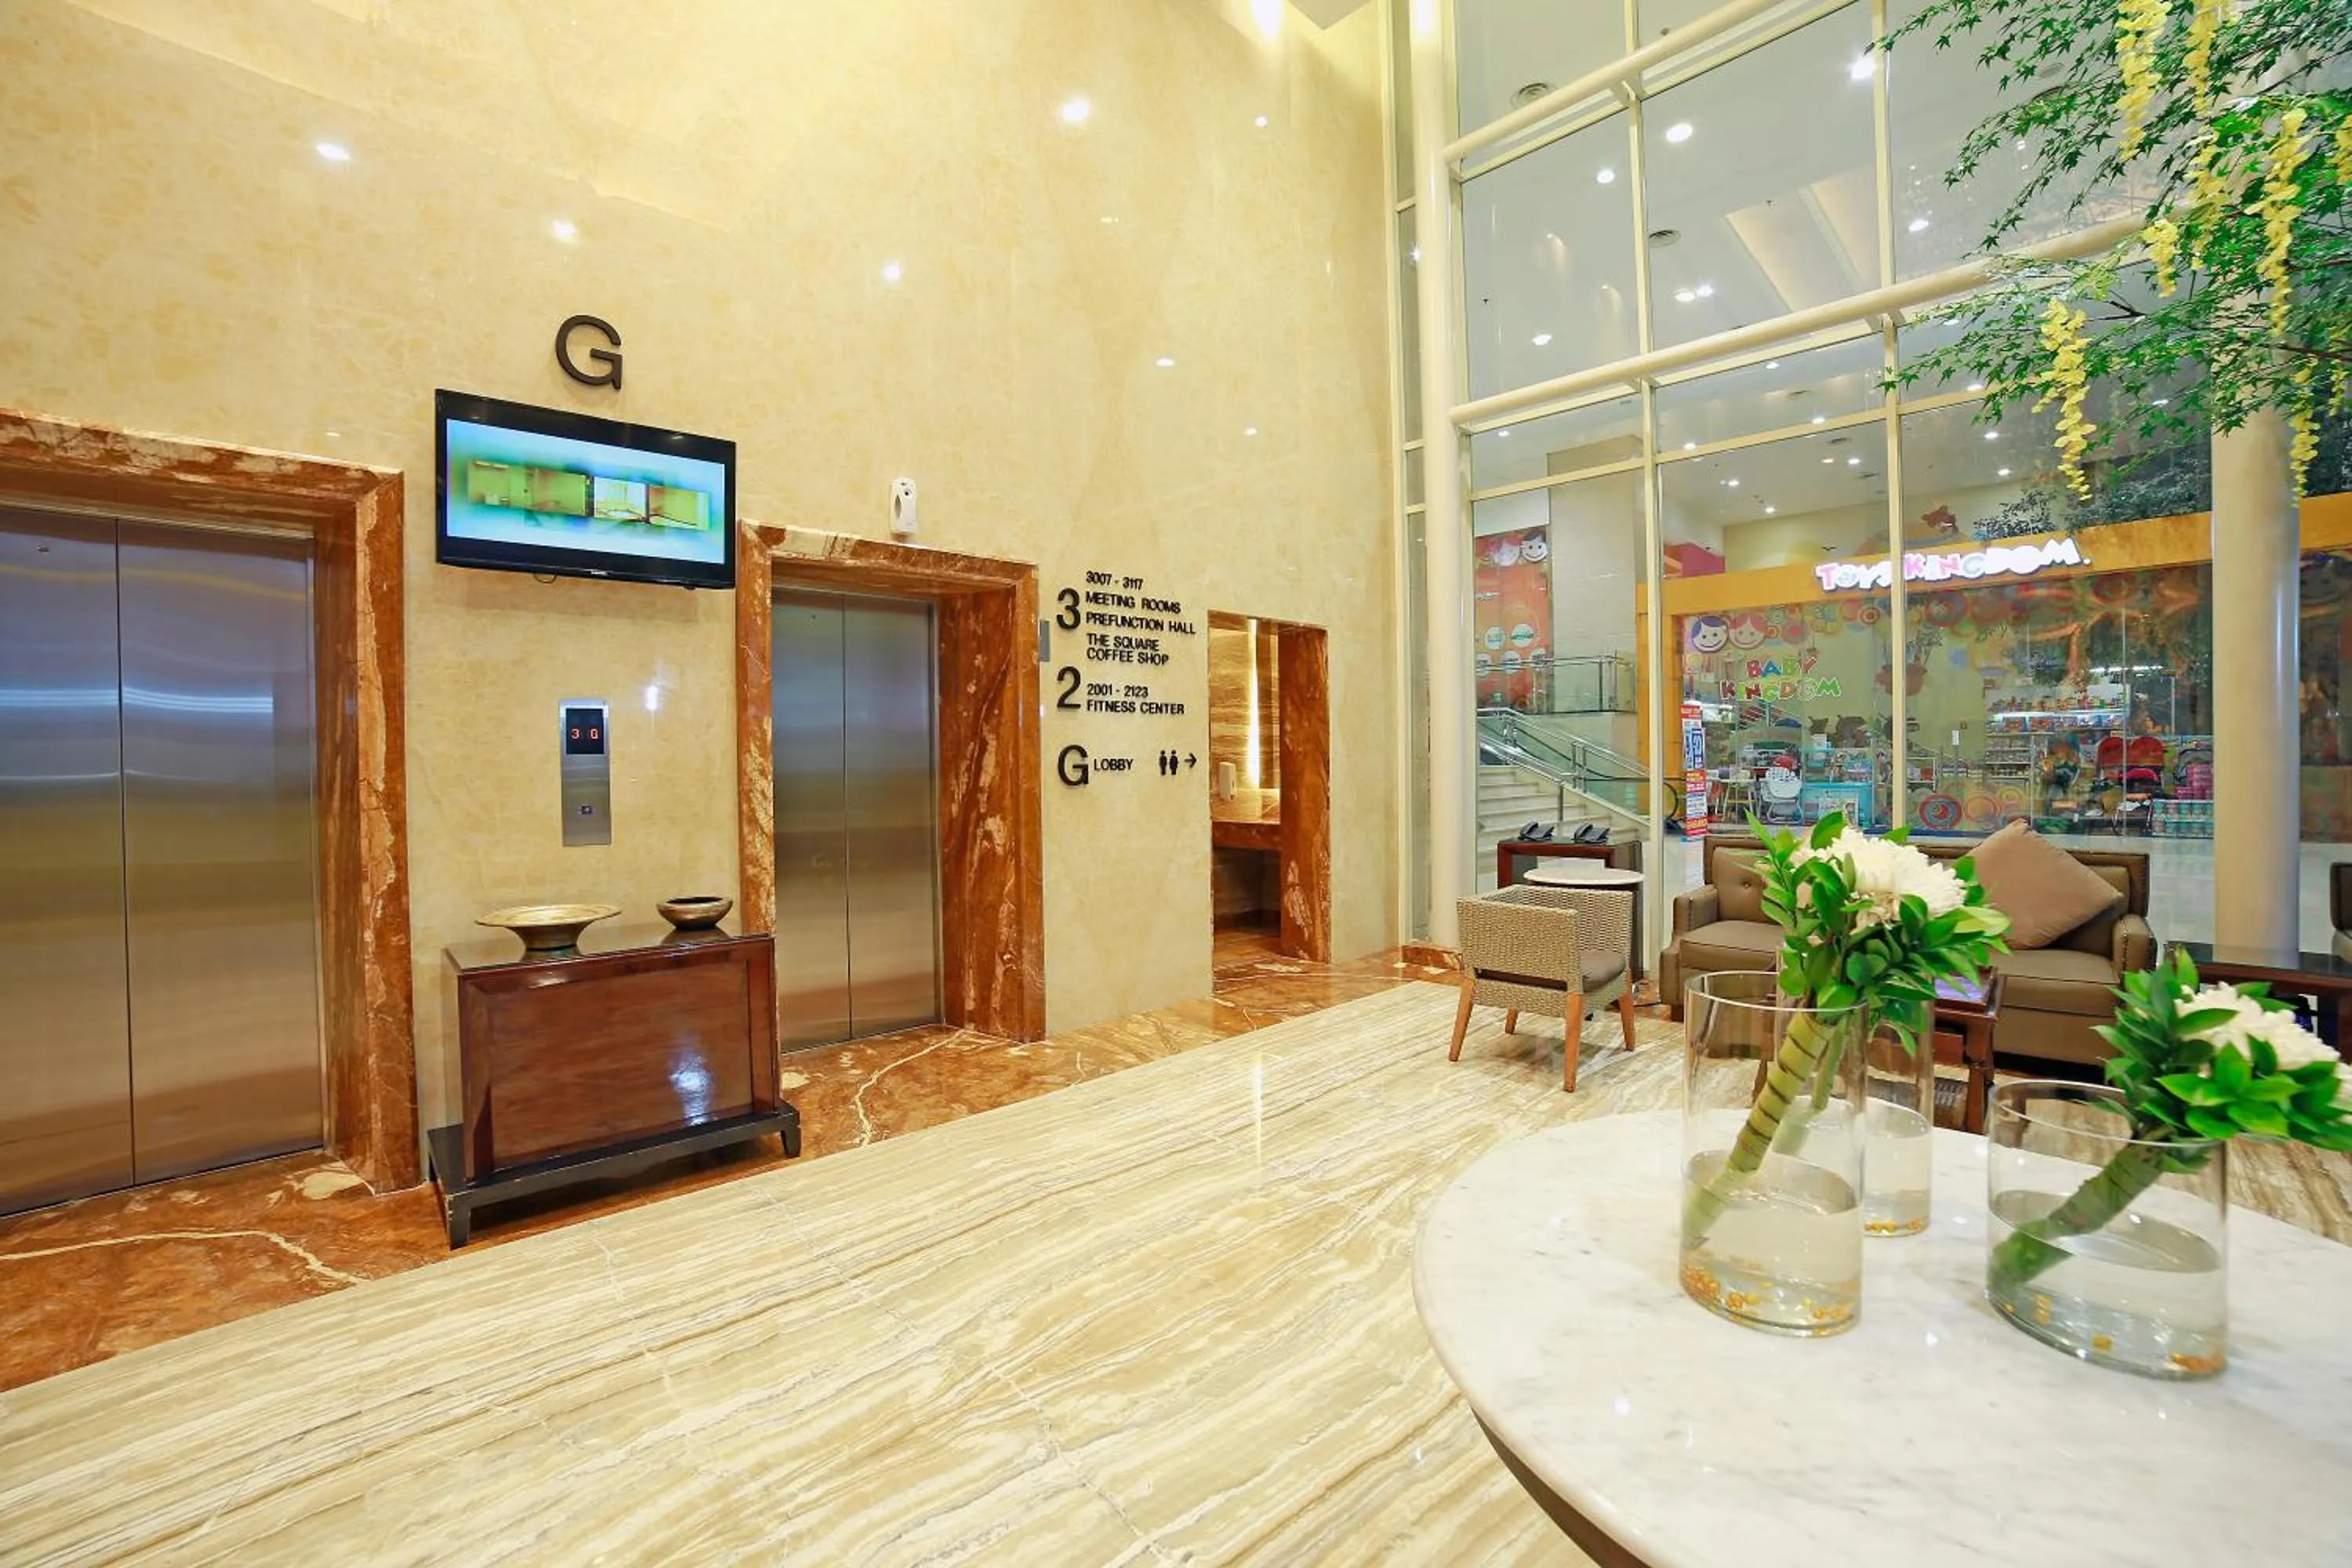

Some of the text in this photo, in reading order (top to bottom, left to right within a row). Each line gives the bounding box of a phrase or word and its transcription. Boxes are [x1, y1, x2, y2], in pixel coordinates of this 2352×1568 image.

[555, 314, 623, 390] G
[1086, 571, 1112, 586] 3007
[1122, 576, 1143, 590] 3117
[1056, 588, 1080, 630] 3
[1085, 591, 1181, 614] MEETING ROOMS
[1086, 612, 1196, 634] PREFUNCTION HALL
[1087, 633, 1160, 652] THE SQUARE
[1087, 648, 1169, 666] COFFEE SHOP
[1747, 656, 1817, 678] BABY
[1056, 666, 1081, 709] 2
[1087, 684, 1113, 696] 2001
[1124, 685, 1149, 698] 2123
[1720, 677, 1842, 702] KINGDOM
[1087, 699, 1185, 714] FITNESS CENTER
[572, 728, 579, 739] 3
[1058, 745, 1134, 786] G LOBBY
